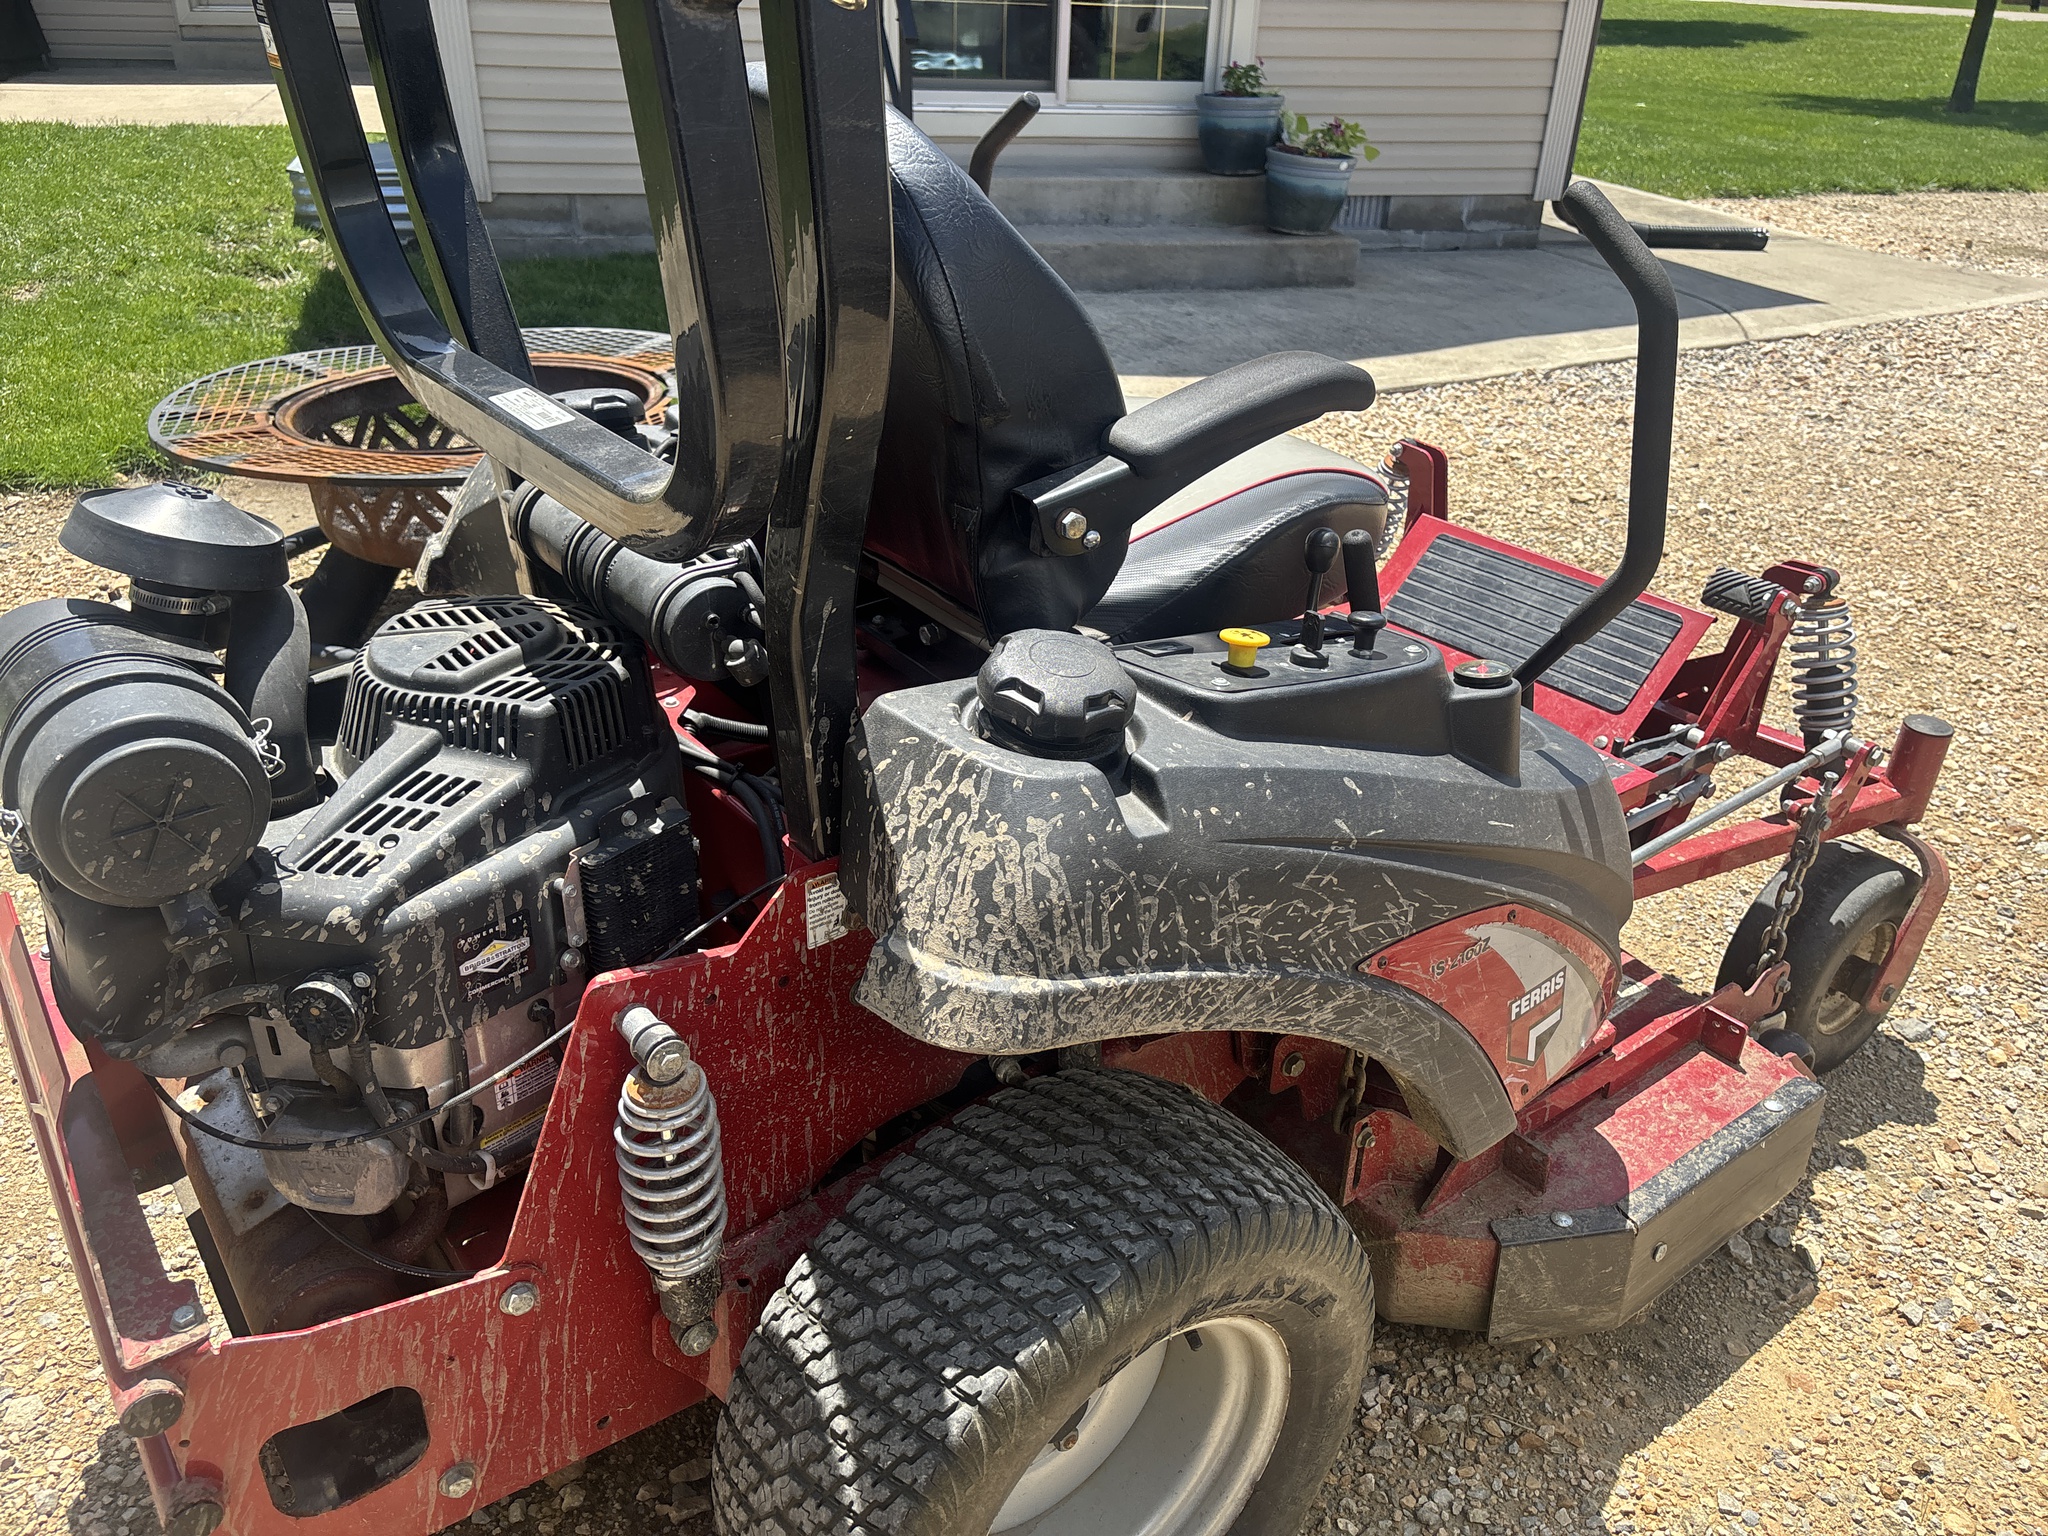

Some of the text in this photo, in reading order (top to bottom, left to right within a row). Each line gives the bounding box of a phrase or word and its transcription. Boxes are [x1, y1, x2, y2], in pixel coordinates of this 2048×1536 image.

[512, 915, 522, 924] BY
[468, 966, 529, 996] COMMERCIAL POWER
[1511, 971, 1564, 1021] FERRIS
